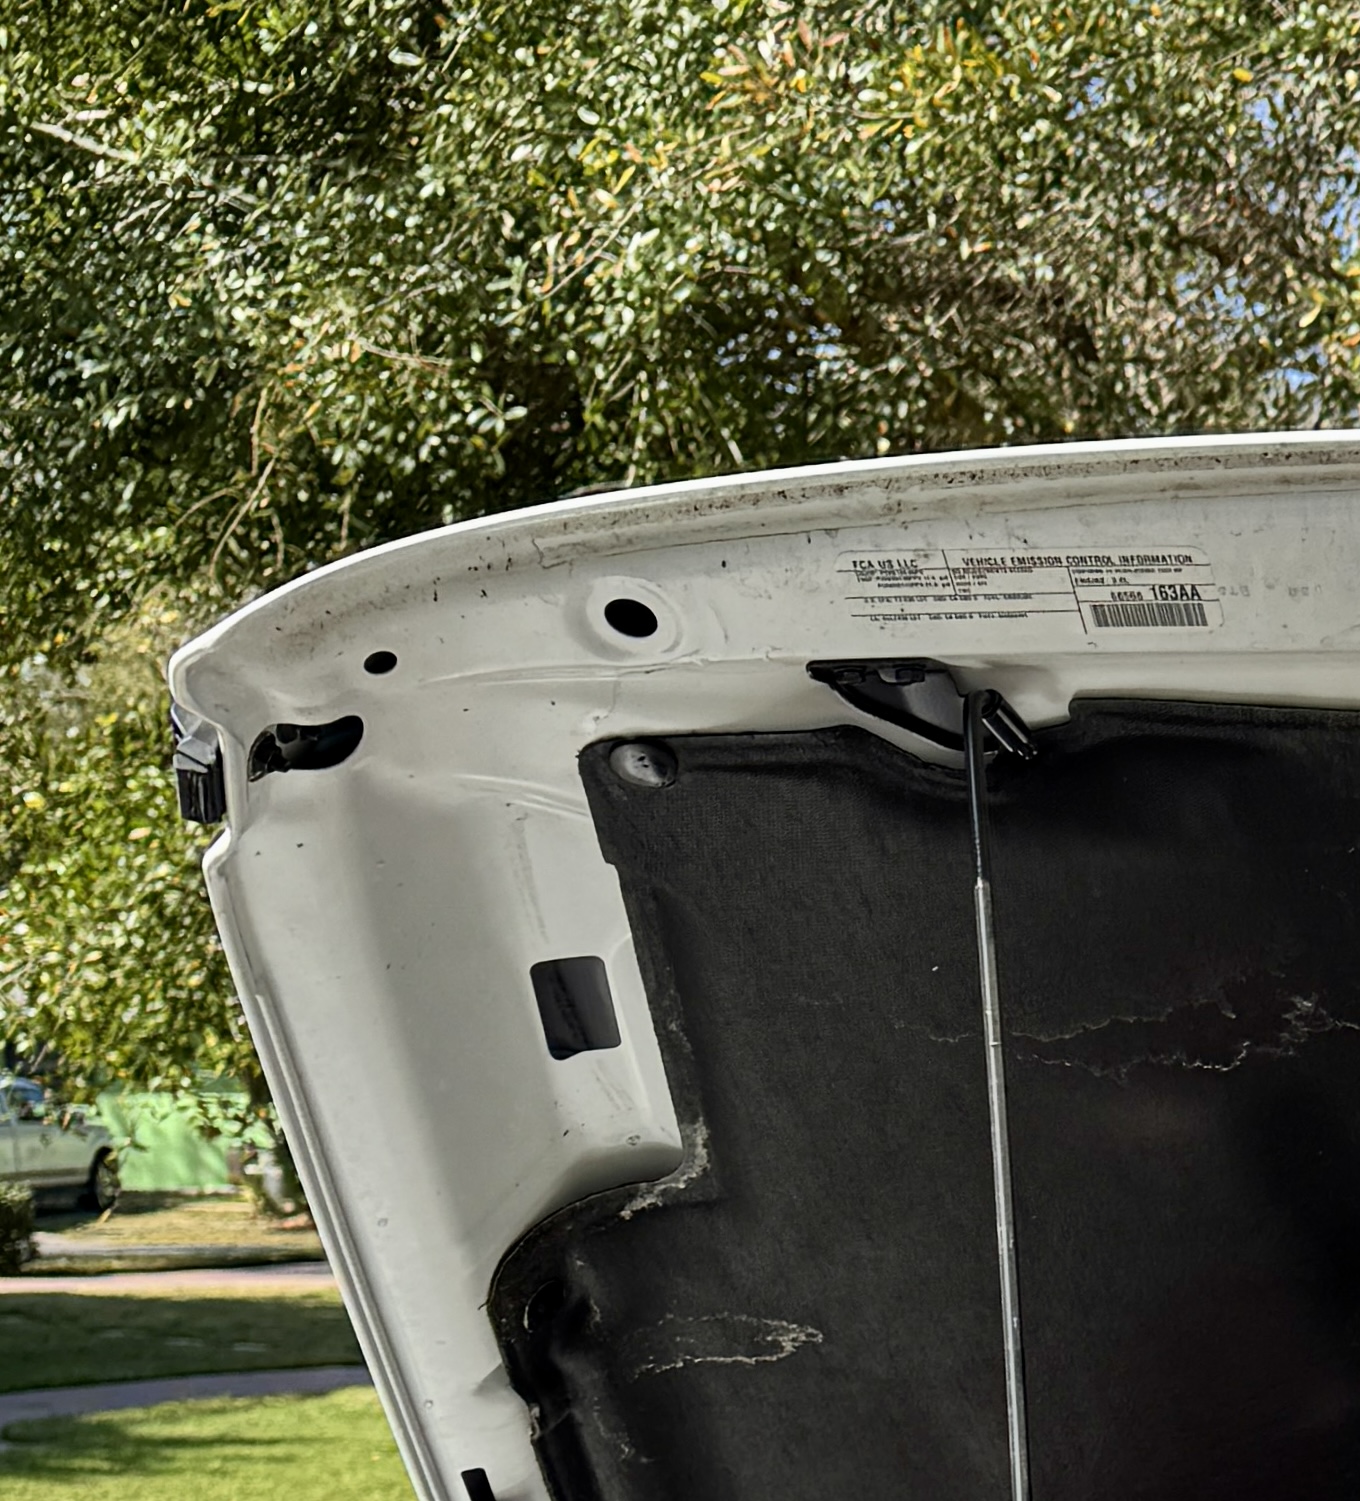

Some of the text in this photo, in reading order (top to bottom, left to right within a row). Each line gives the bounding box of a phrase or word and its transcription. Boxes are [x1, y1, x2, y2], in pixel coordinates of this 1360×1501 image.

[962, 554, 1193, 567] VEHICLE EMISSION CONTROL INFORMATION
[1149, 585, 1202, 601] 163AA
